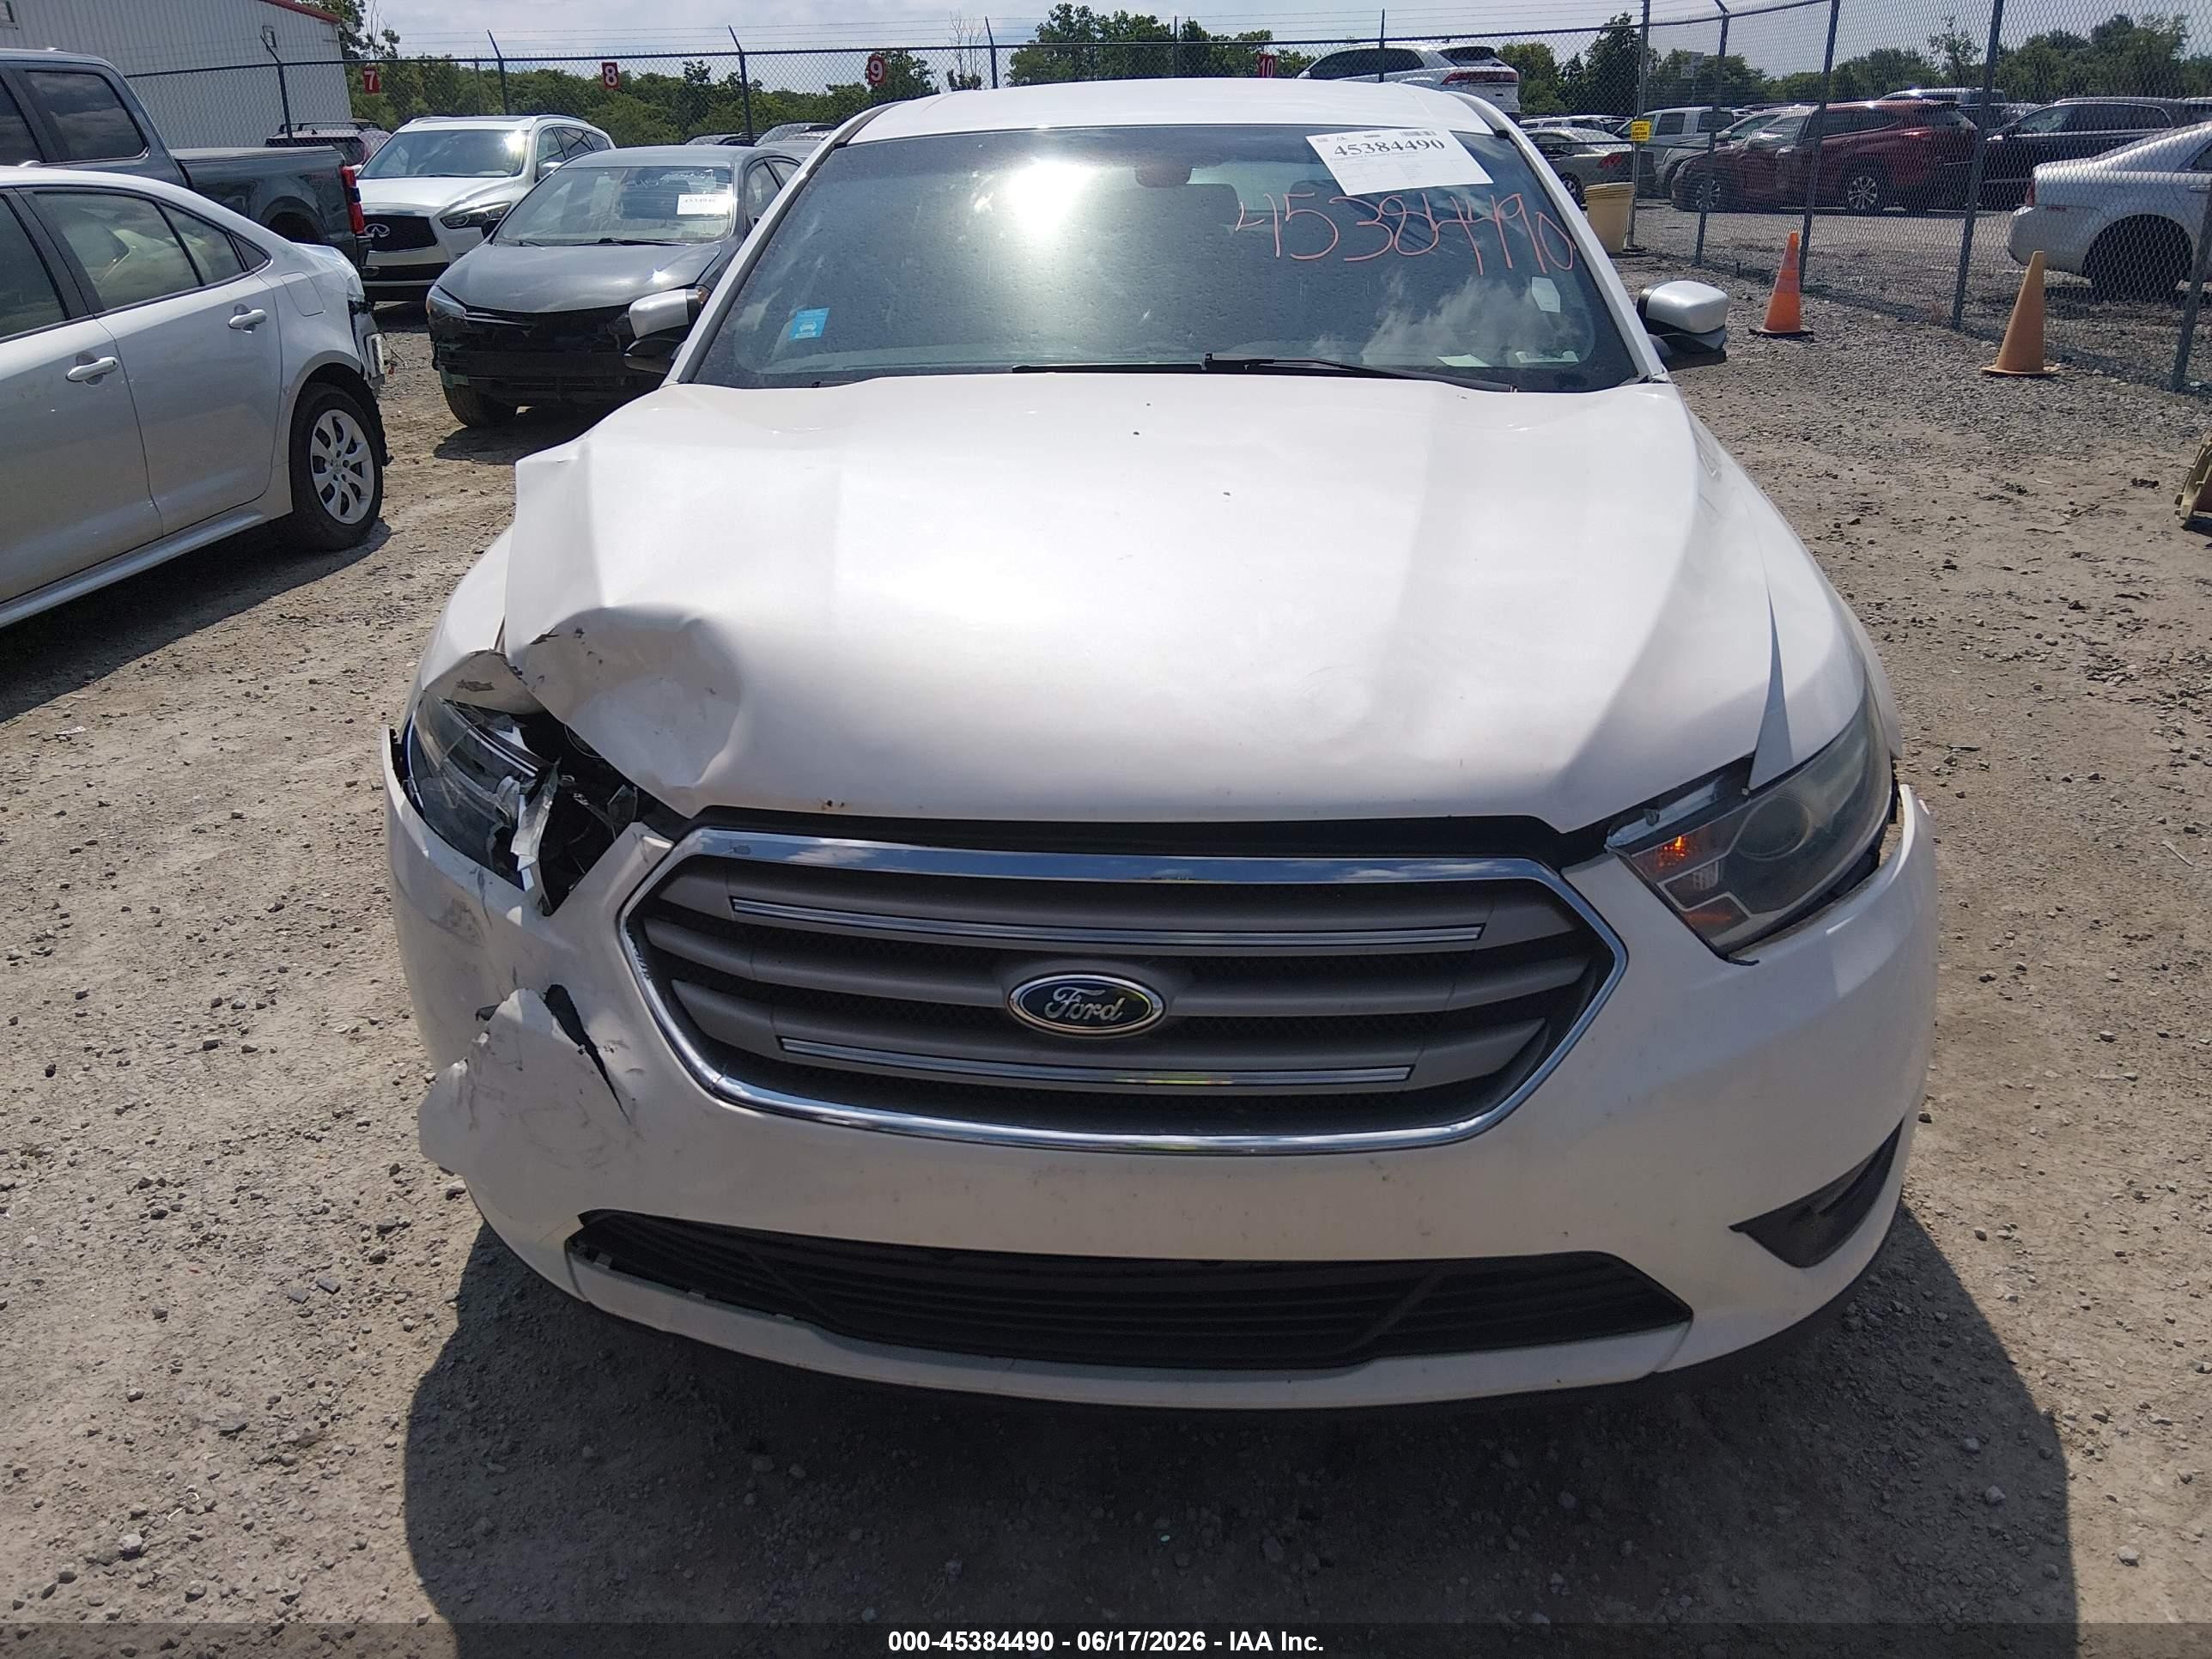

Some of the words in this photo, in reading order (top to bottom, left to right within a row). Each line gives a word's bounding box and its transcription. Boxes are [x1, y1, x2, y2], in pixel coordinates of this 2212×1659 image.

[605, 65, 617, 86] 8
[870, 60, 884, 82] 9
[1260, 58, 1273, 77] 10
[363, 70, 375, 90] 7
[1334, 138, 1445, 156] 45384490
[1235, 191, 1577, 274] 45384490
[1044, 987, 1126, 1021] Ford
